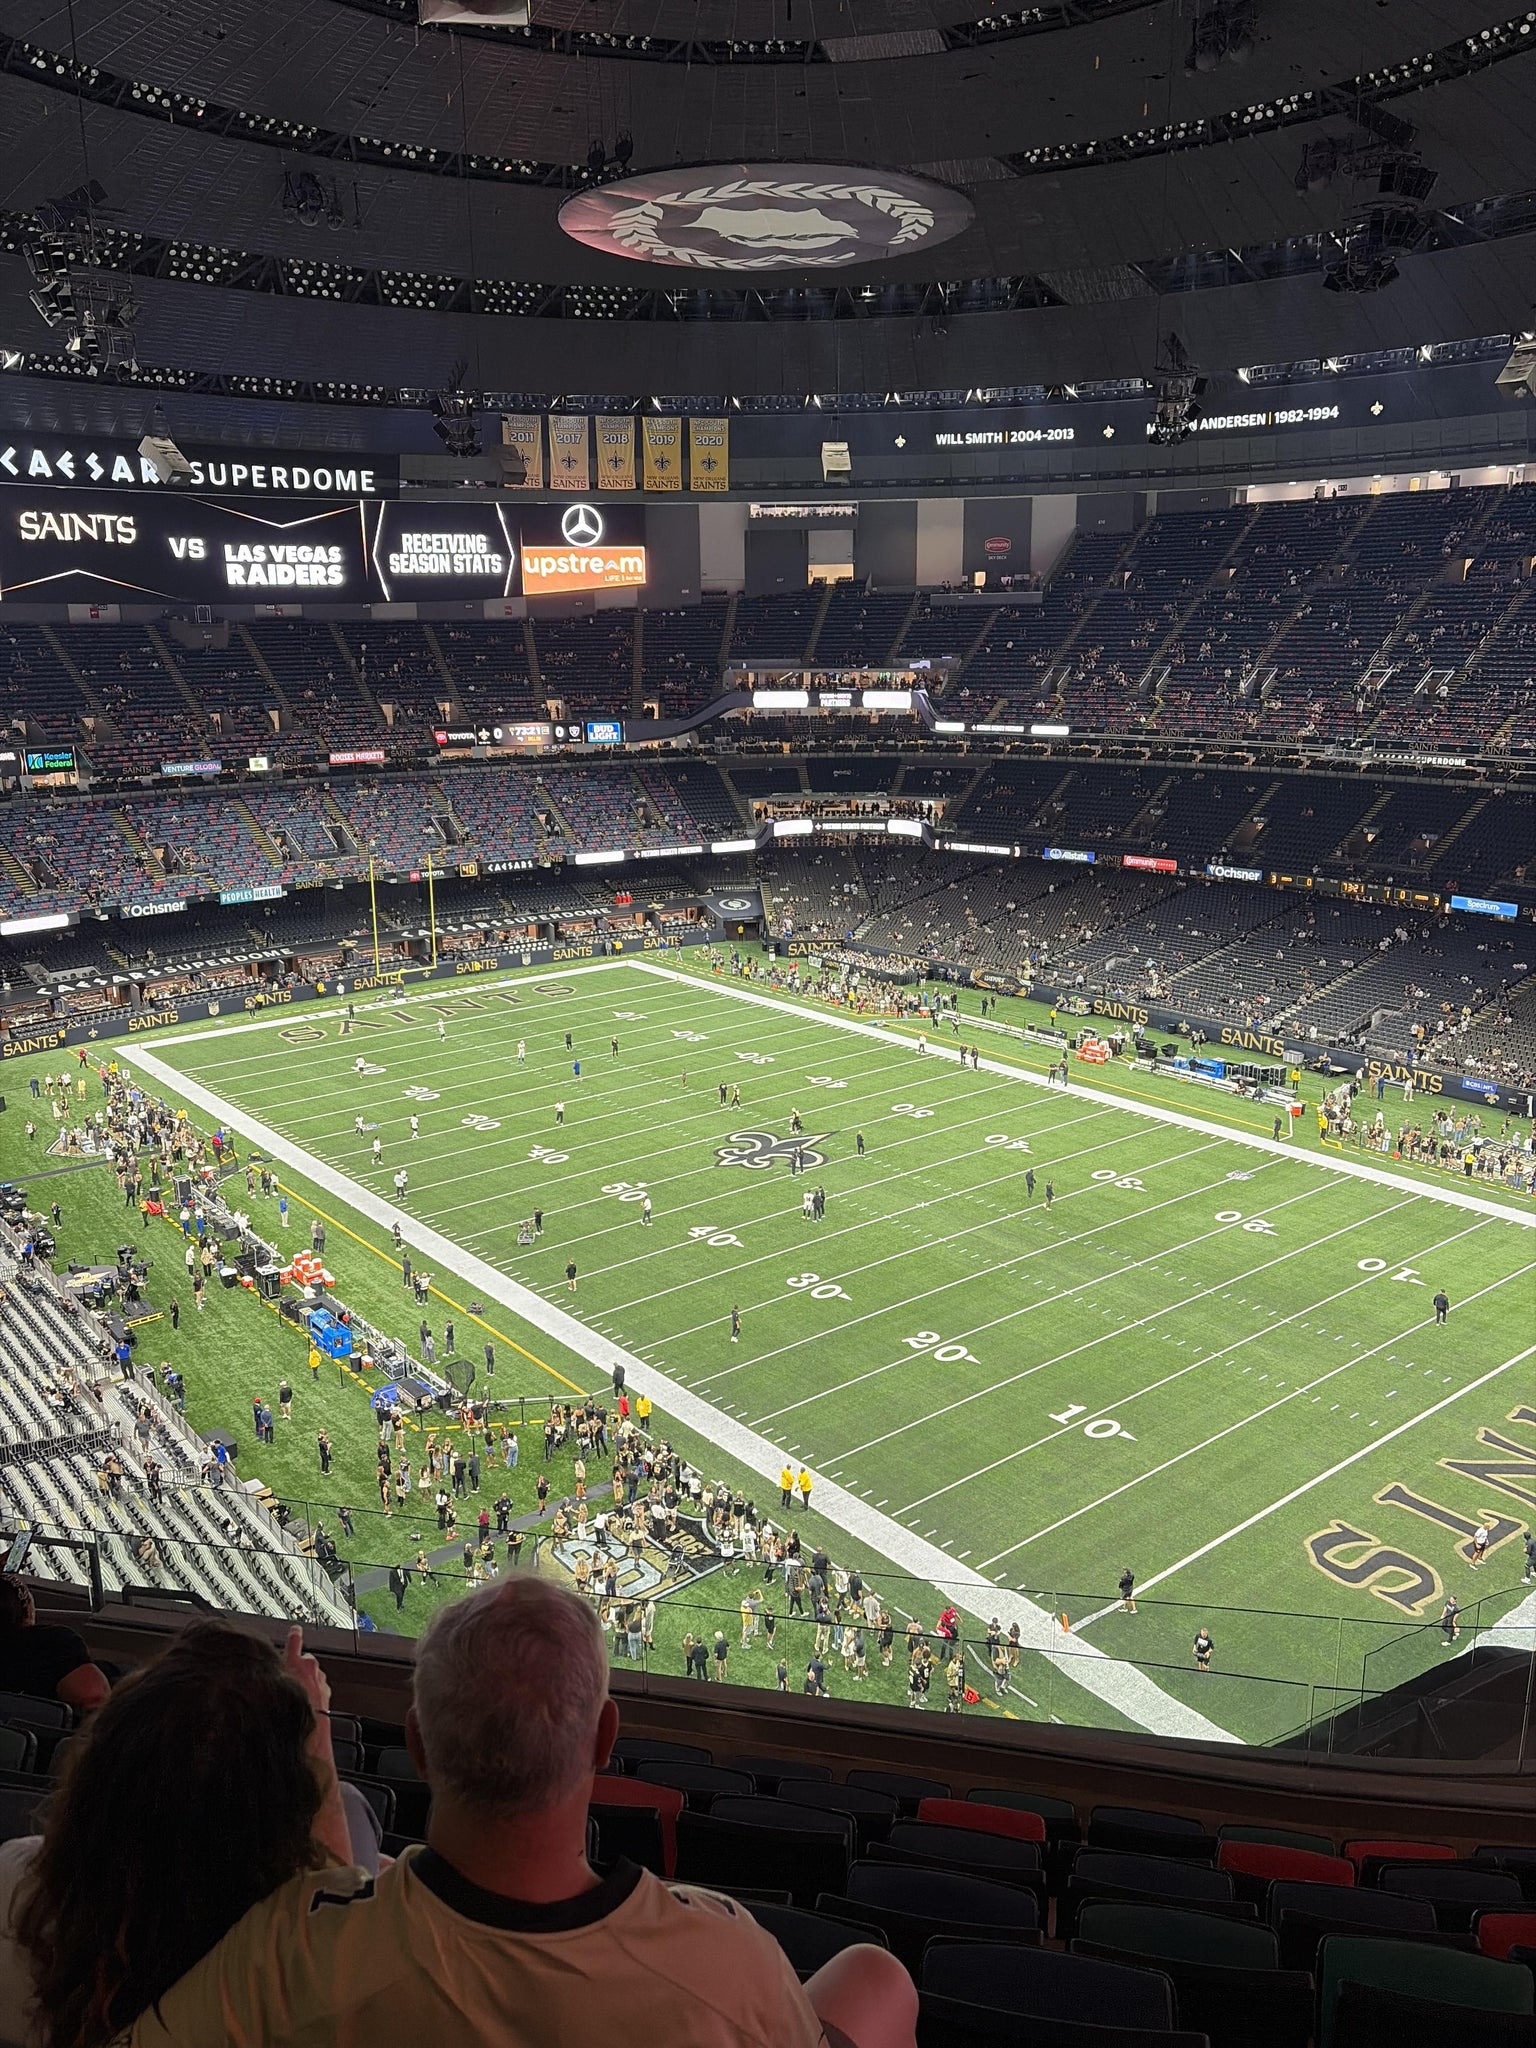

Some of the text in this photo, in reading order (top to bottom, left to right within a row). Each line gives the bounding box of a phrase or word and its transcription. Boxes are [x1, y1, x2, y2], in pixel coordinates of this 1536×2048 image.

[1200, 412, 1267, 431] ANDERSEN
[1274, 405, 1340, 425] 1982-1994
[510, 431, 534, 442] 2011
[556, 433, 582, 444] 2017
[602, 433, 629, 444] 2018
[649, 435, 675, 445] 2019
[695, 436, 723, 446] 2020
[936, 428, 1075, 445] WILL SMITH 2004-2013
[0, 446, 376, 492] CAESAR SUPERDOME
[553, 480, 587, 489] SAINTS
[600, 480, 634, 488] SAINTS
[646, 480, 680, 489] SAINTS
[693, 481, 726, 490] SAINTS
[19, 511, 138, 545] SAINTS
[168, 538, 206, 560] VS
[401, 533, 488, 553] RECEIVING
[224, 544, 342, 564] LAS VEGAS
[389, 553, 503, 574] SEASON STATS
[226, 563, 344, 587] RAIDERS
[493, 727, 503, 740] 0
[555, 726, 565, 738] 0
[593, 724, 614, 732] BUD
[1104, 727, 1129, 735] SAINTS
[1160, 730, 1185, 738] SAINTS
[448, 732, 475, 740] TOYOTA
[590, 732, 618, 740] LIGHT
[1216, 731, 1243, 740] SAINTS
[1275, 735, 1303, 743] SAINTS
[390, 749, 416, 757] SAINTS
[1205, 744, 1230, 752] SAINTS
[1260, 747, 1287, 756] SAINTS
[1409, 742, 1439, 751] SAINTS
[1479, 746, 1511, 756] SAINTS
[44, 752, 72, 760] Keesler
[356, 751, 384, 760] MARKETS
[45, 759, 73, 768] Federal
[162, 763, 221, 773] VENTURE GLOBAL
[1495, 761, 1526, 770] SAINTS
[122, 766, 151, 775] SAINTS
[1061, 851, 1089, 861] Allstate
[1126, 855, 1157, 868] Community
[462, 865, 475, 875] 40
[487, 859, 534, 872] CAESARS
[357, 873, 385, 883] SAINTS
[1214, 866, 1261, 881] Ochsner
[1271, 874, 1277, 884] 3
[295, 880, 324, 890] SAINTS
[1306, 877, 1312, 887] 0
[1343, 882, 1365, 893] 73:21
[222, 886, 281, 904] PEOPLES HEALTH
[1399, 890, 1406, 900] 0
[1434, 897, 1440, 906] 3
[131, 900, 186, 917] Ochsner
[1467, 899, 1498, 912] Spectrum
[400, 907, 612, 938] CAESARS SUPERDOME
[643, 935, 682, 949] SAINTS
[788, 941, 842, 956] SAINTS
[553, 945, 593, 961] SAINTS
[36, 947, 294, 995] CAESARS SUPERDOME
[456, 958, 498, 975] SAINTS
[353, 973, 405, 990] SAINTS
[245, 990, 292, 1009] SINTS
[278, 982, 578, 1045] SAINTS
[334, 1000, 395, 1014] TKES
[1093, 999, 1149, 1025] SAINTS
[128, 1010, 179, 1031] SAINTS
[3, 1033, 60, 1057] SAINTS
[1220, 1027, 1285, 1057] SAINTS
[1368, 1060, 1443, 1094] SAINTS
[402, 1085, 441, 1102] 20
[891, 1102, 935, 1119] 50
[461, 1112, 501, 1131] 30
[527, 1143, 570, 1165] 40
[1090, 1168, 1143, 1192] 30
[600, 1180, 647, 1202] 50
[1214, 1209, 1275, 1236] 20
[686, 1224, 738, 1248] 40
[1356, 1257, 1421, 1285] 10
[786, 1272, 845, 1300] 30
[901, 1330, 970, 1363] 20
[1047, 1402, 1123, 1440] 10
